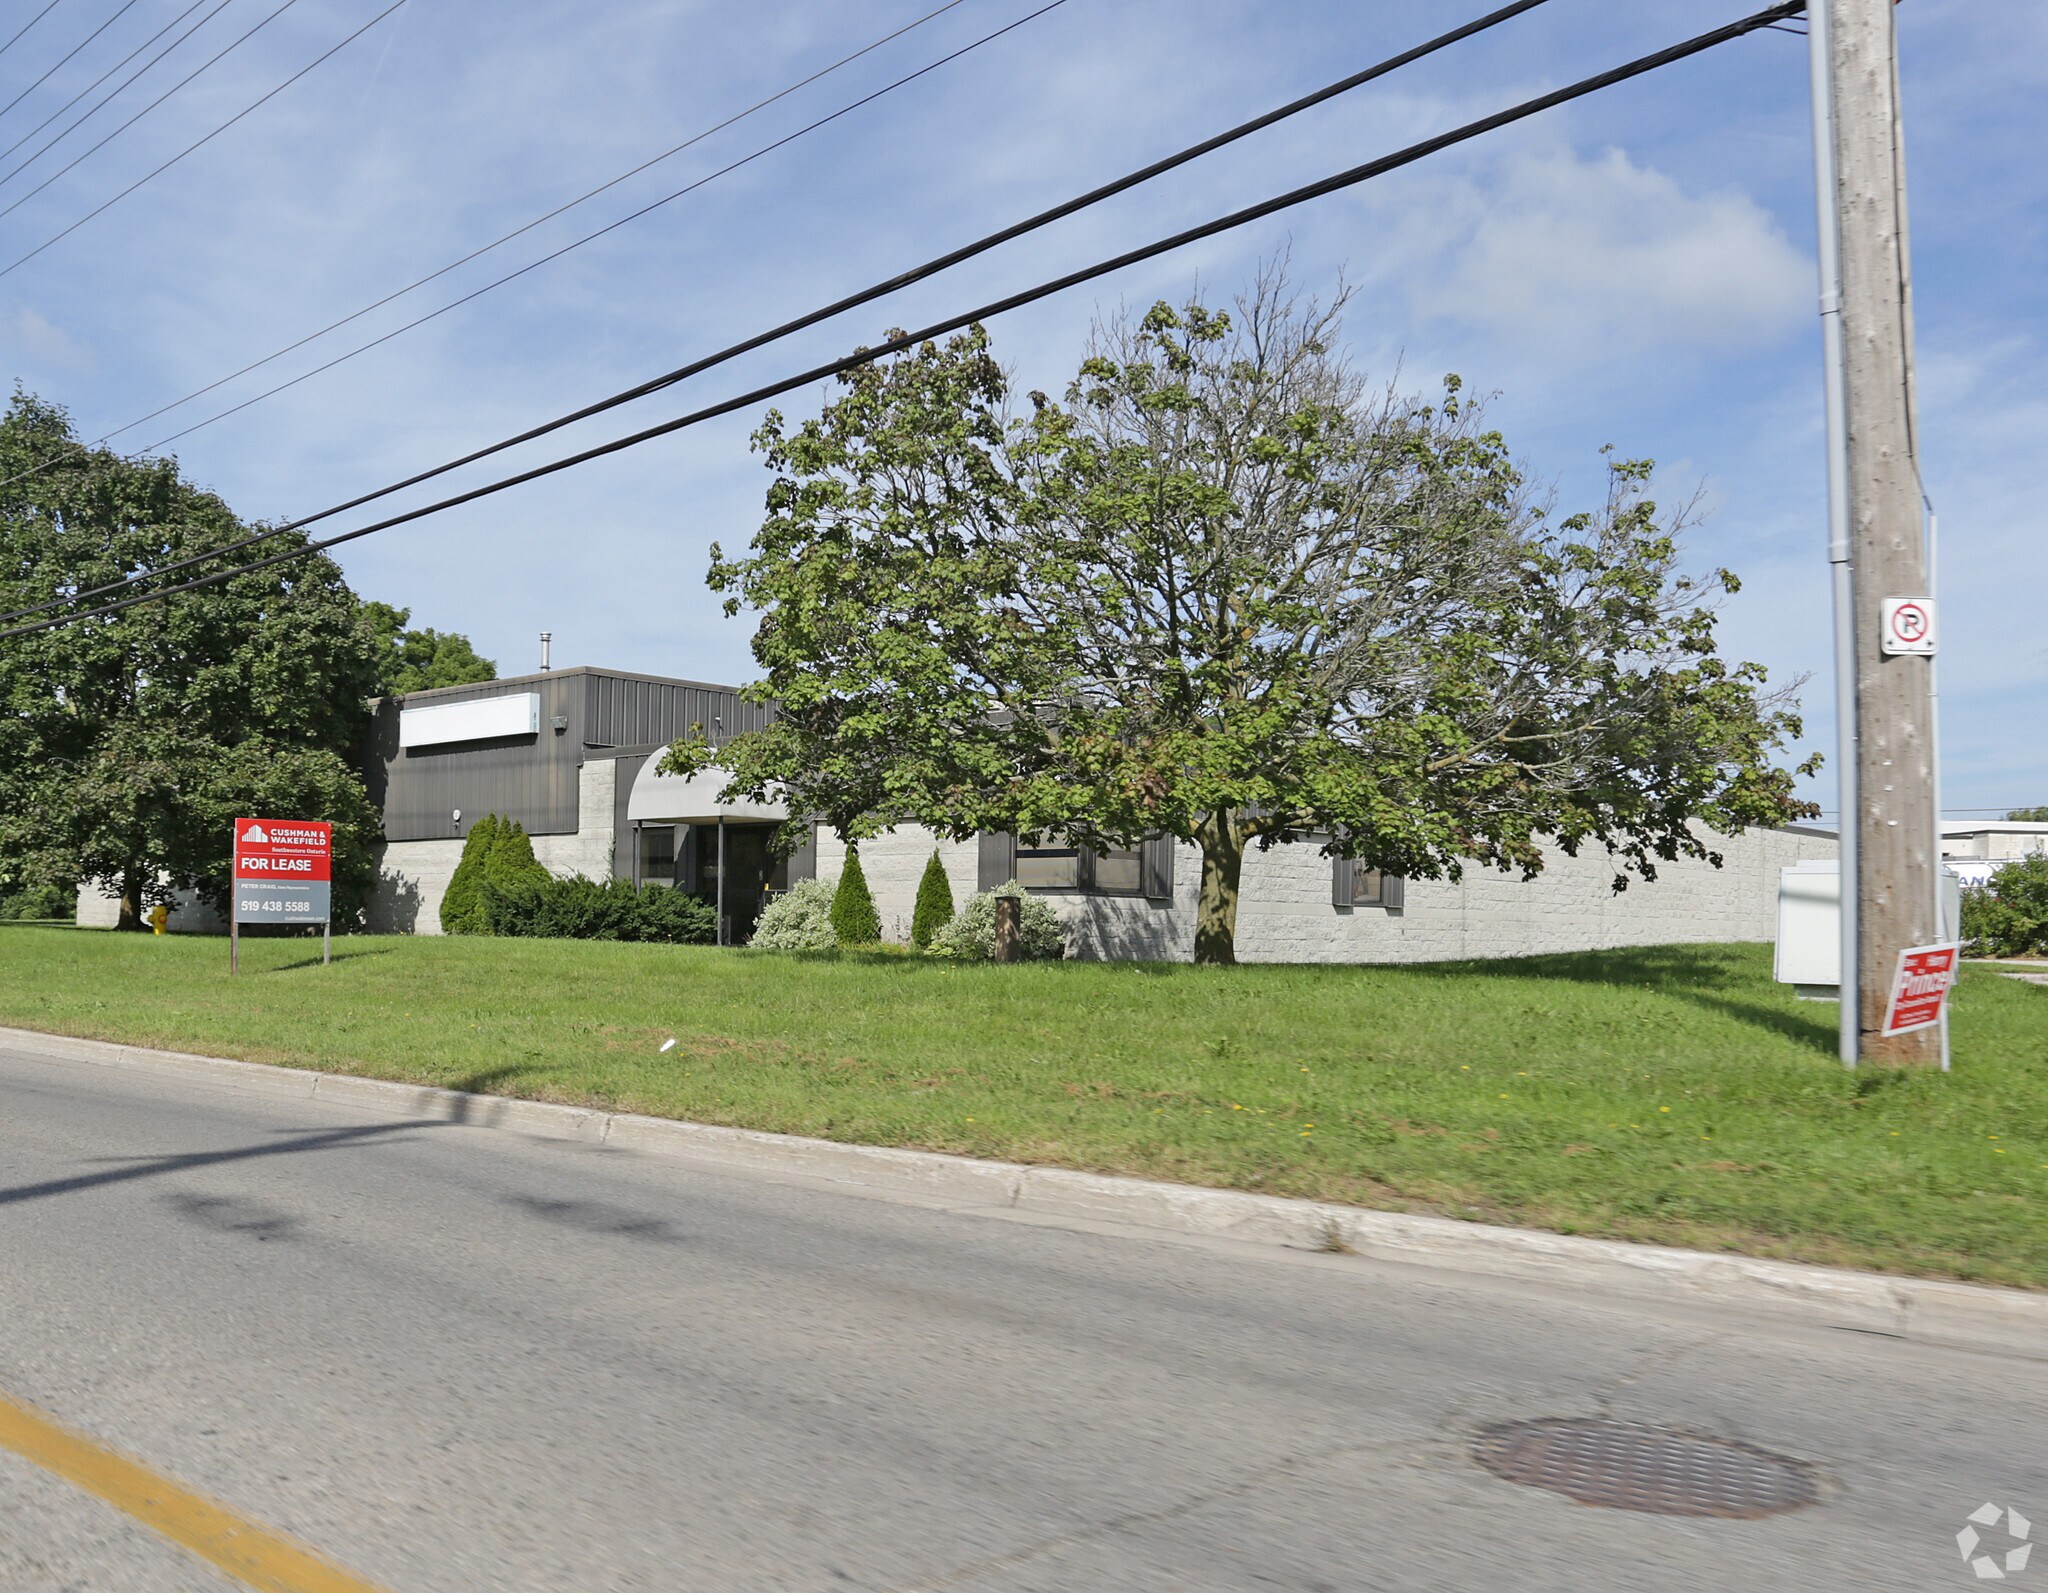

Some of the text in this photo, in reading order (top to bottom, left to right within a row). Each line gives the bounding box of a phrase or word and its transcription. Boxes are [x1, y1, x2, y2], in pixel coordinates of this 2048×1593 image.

[270, 829, 317, 837] CUSHMAN
[271, 836, 326, 845] WAKEFIELD
[241, 857, 312, 871] FOR LEASE
[241, 900, 310, 912] 519 438 5588
[1899, 970, 1948, 998] Prince
